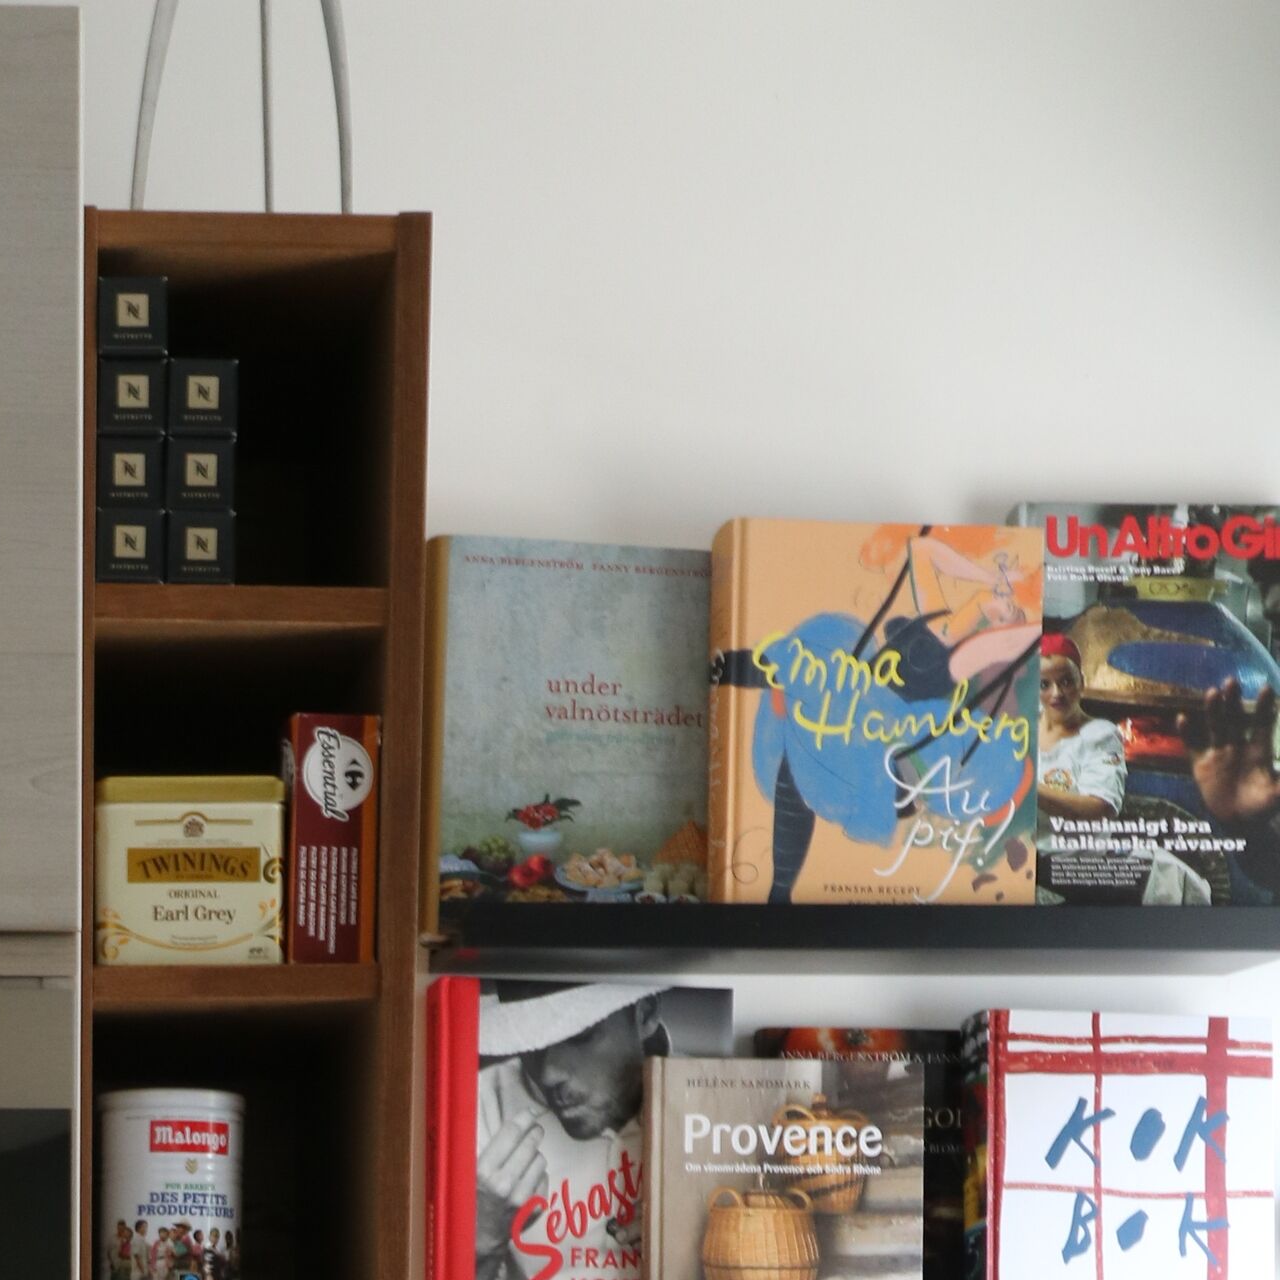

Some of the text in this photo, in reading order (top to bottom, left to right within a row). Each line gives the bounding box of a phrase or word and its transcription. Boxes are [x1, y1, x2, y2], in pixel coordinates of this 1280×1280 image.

[1045, 514, 1109, 558] Un
[635, 565, 712, 578] BERGENSTRÖ
[751, 630, 905, 694] Emma
[547, 673, 622, 696] under
[545, 699, 703, 728] valnötsträdet
[793, 680, 1030, 760] Hamberg
[317, 729, 349, 820] Essential
[884, 742, 993, 816] Au
[1049, 816, 1212, 836] Vansinnigt bra
[1164, 834, 1247, 852] råvaror
[137, 851, 252, 879] TWININGS
[168, 888, 219, 899] ORIGINAL
[153, 905, 236, 925] Earl Grey
[154, 1126, 228, 1151] Malongo
[684, 1113, 883, 1158] Provence
[685, 1162, 702, 1173] Om
[764, 1162, 804, 1175] Provence
[150, 1191, 178, 1204] DES
